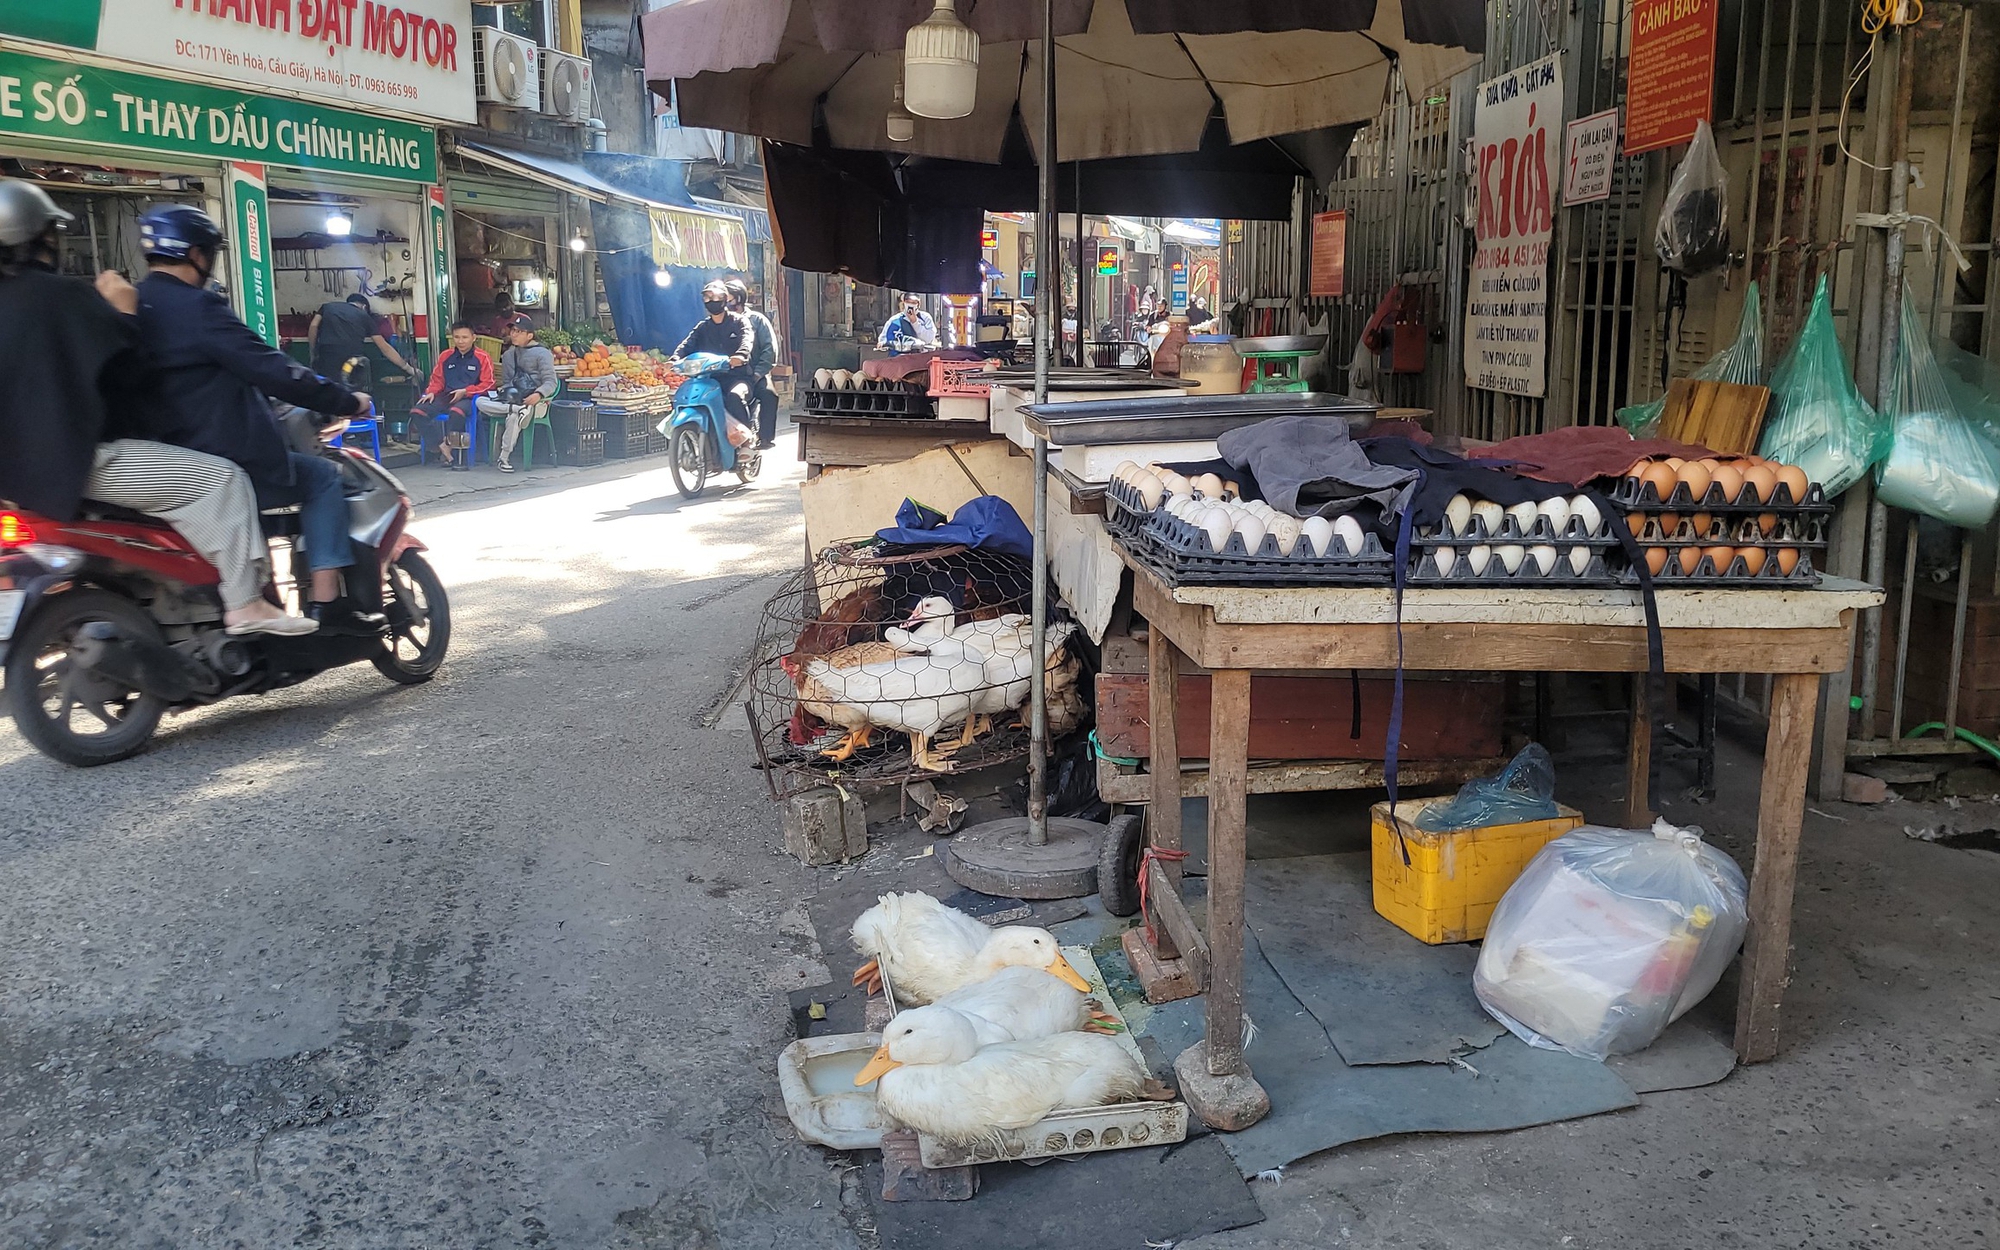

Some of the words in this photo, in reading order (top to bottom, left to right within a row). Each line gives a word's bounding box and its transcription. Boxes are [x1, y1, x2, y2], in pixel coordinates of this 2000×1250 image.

[298, 0, 358, 57] ĐẠT
[362, 0, 458, 72] MOTOR
[1638, 3, 1671, 36] CẢNH
[175, 39, 196, 58] ĐC:
[198, 44, 218, 62] 171
[220, 47, 239, 66] Yên
[268, 57, 287, 74] Cầu
[289, 62, 312, 83] Giấy,
[314, 66, 326, 82] Hà
[328, 70, 343, 89] Nội
[350, 74, 364, 90] ĐT.
[365, 76, 385, 94] 0963
[387, 81, 402, 96] 665
[403, 84, 418, 99] 998
[528, 64, 534, 74] LG
[582, 82, 588, 91] LG
[33, 74, 86, 126] SỐ
[112, 93, 201, 141] THAY
[208, 101, 270, 149] DẦU
[276, 118, 354, 161] CHÍNH
[359, 128, 421, 170] HÃNG
[248, 214, 260, 260] Castrol
[253, 267, 264, 307] BIKE
